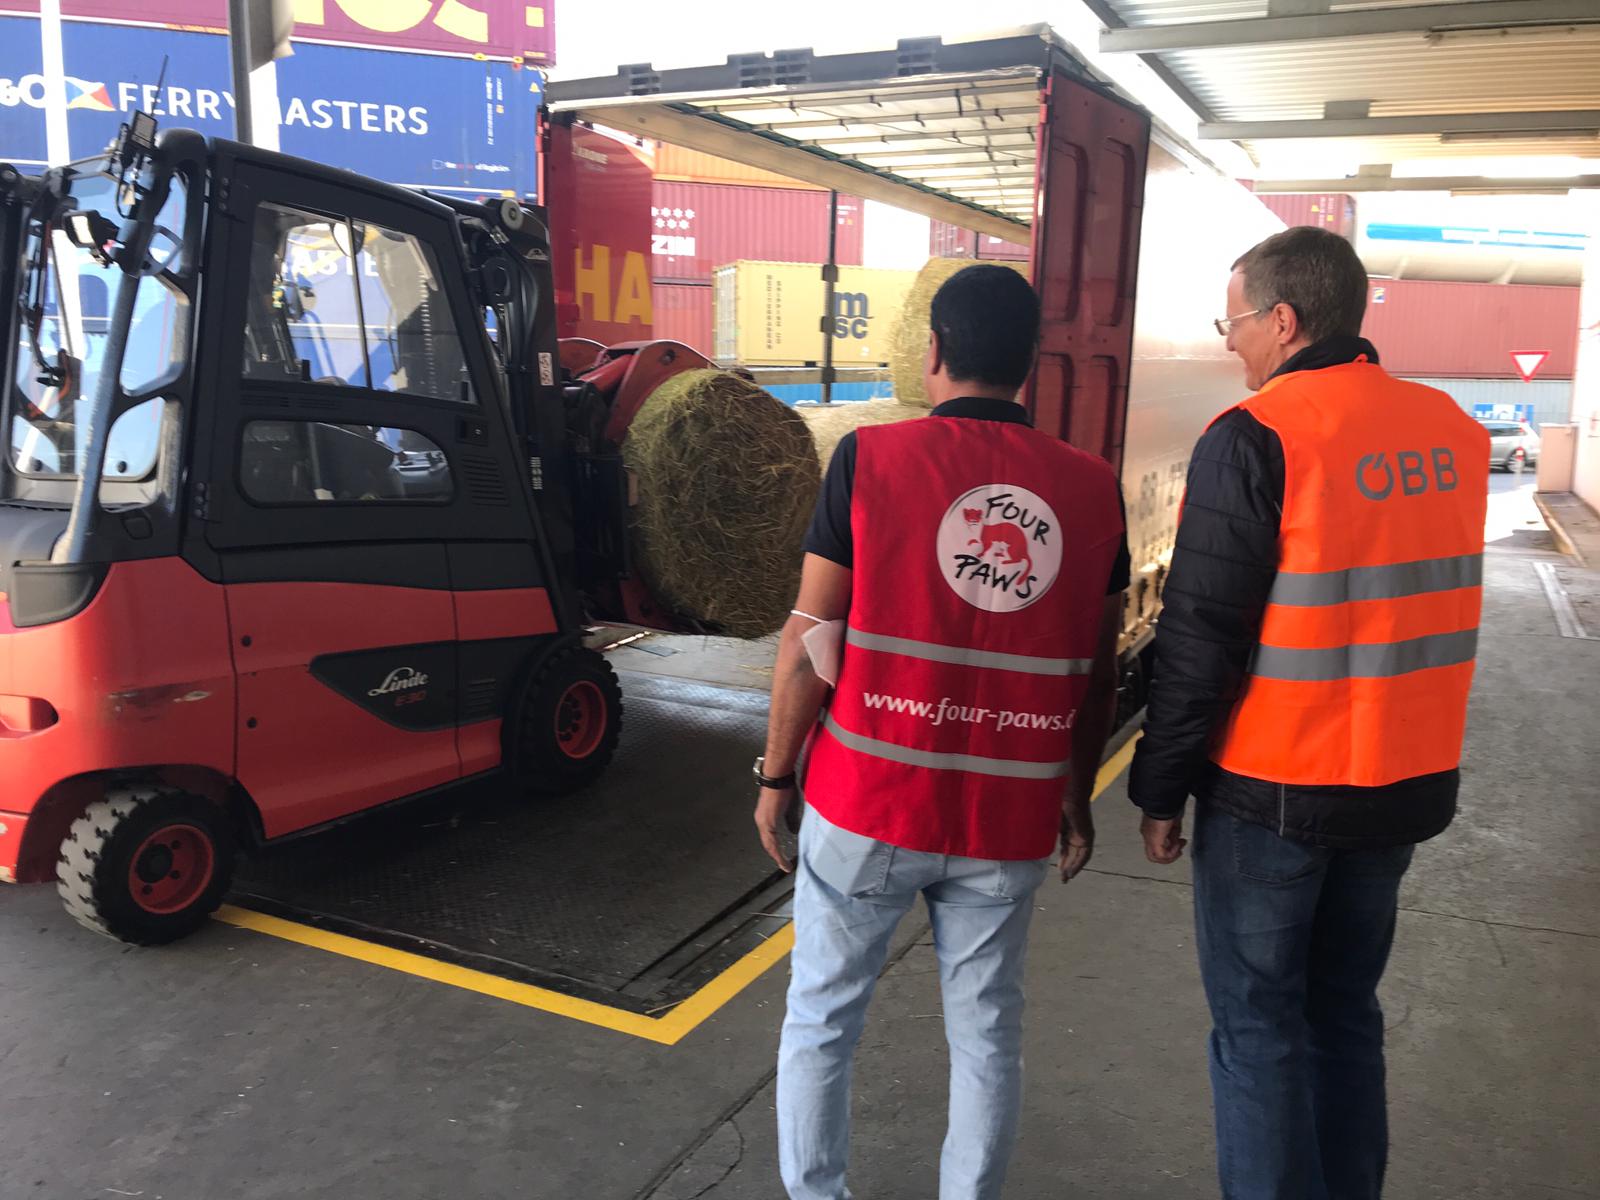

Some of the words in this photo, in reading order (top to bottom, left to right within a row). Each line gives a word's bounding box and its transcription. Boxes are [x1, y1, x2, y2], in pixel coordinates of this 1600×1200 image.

[117, 81, 235, 121] FERR
[272, 96, 429, 136] ASTERS
[651, 235, 696, 256] ZIM
[985, 493, 1050, 546] FOUR
[953, 553, 1038, 599] PAWS
[367, 666, 428, 697] Linde
